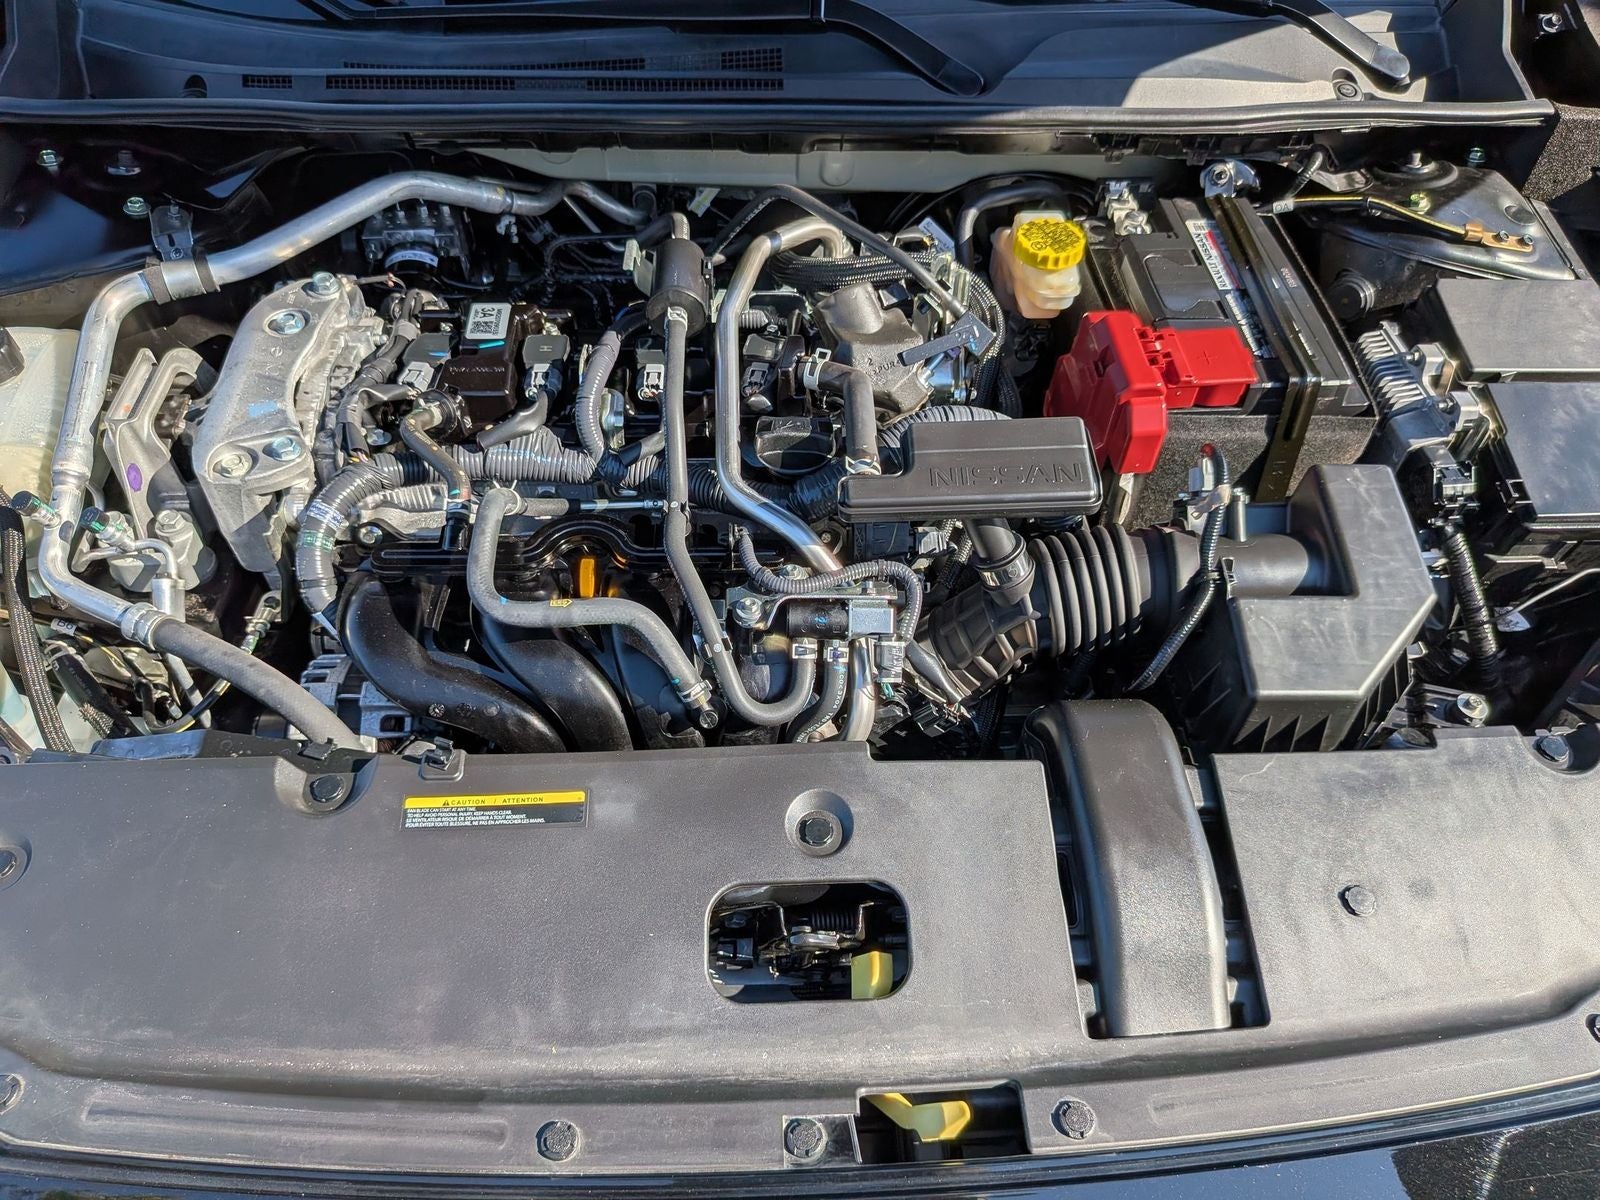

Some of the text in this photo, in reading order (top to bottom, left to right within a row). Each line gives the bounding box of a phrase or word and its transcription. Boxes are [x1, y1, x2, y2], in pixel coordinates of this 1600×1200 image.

[1194, 233, 1213, 261] NISSAN
[479, 307, 495, 318] 3A
[929, 463, 1084, 487] NISSAN
[502, 796, 544, 804] ATTENTION
